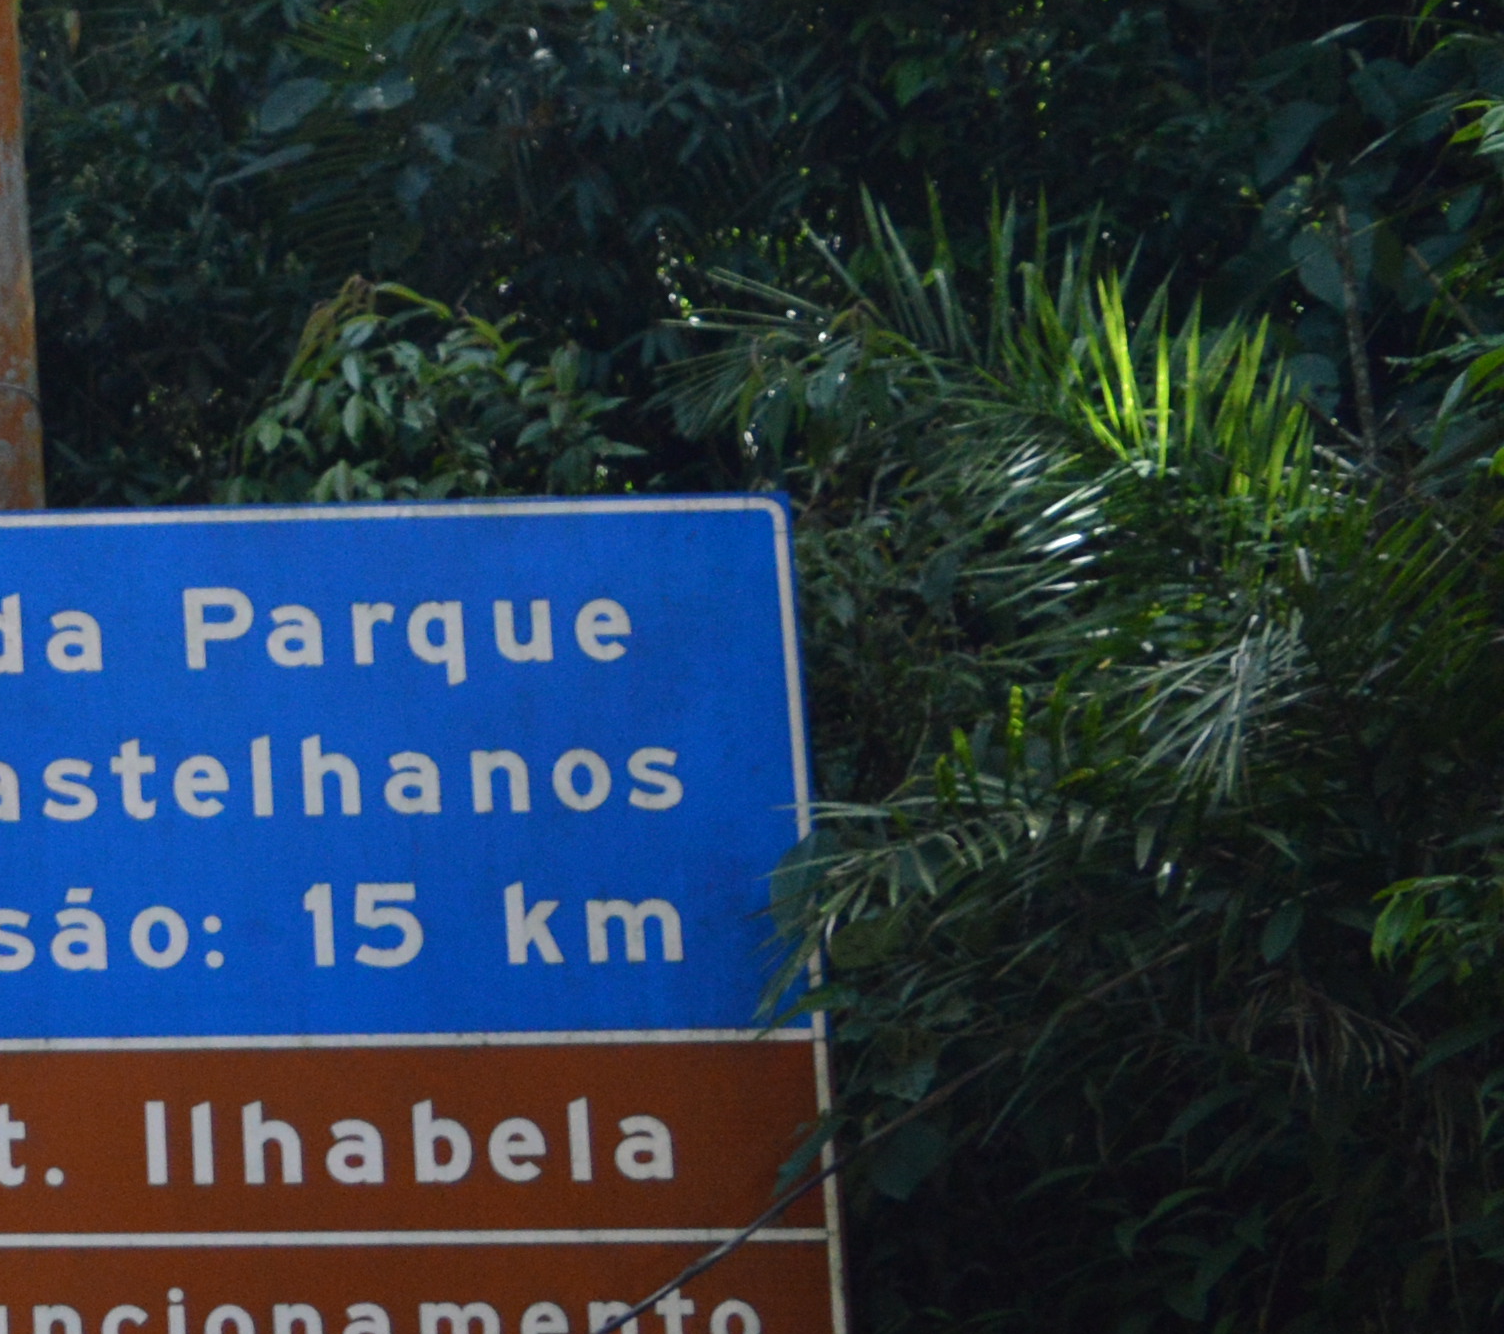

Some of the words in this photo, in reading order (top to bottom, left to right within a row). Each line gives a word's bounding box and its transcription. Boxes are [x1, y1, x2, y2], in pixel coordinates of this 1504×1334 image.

[182, 586, 631, 686] Parque
[303, 883, 424, 968] 15
[503, 881, 683, 965] km
[144, 1097, 673, 1186] Ilhabela
